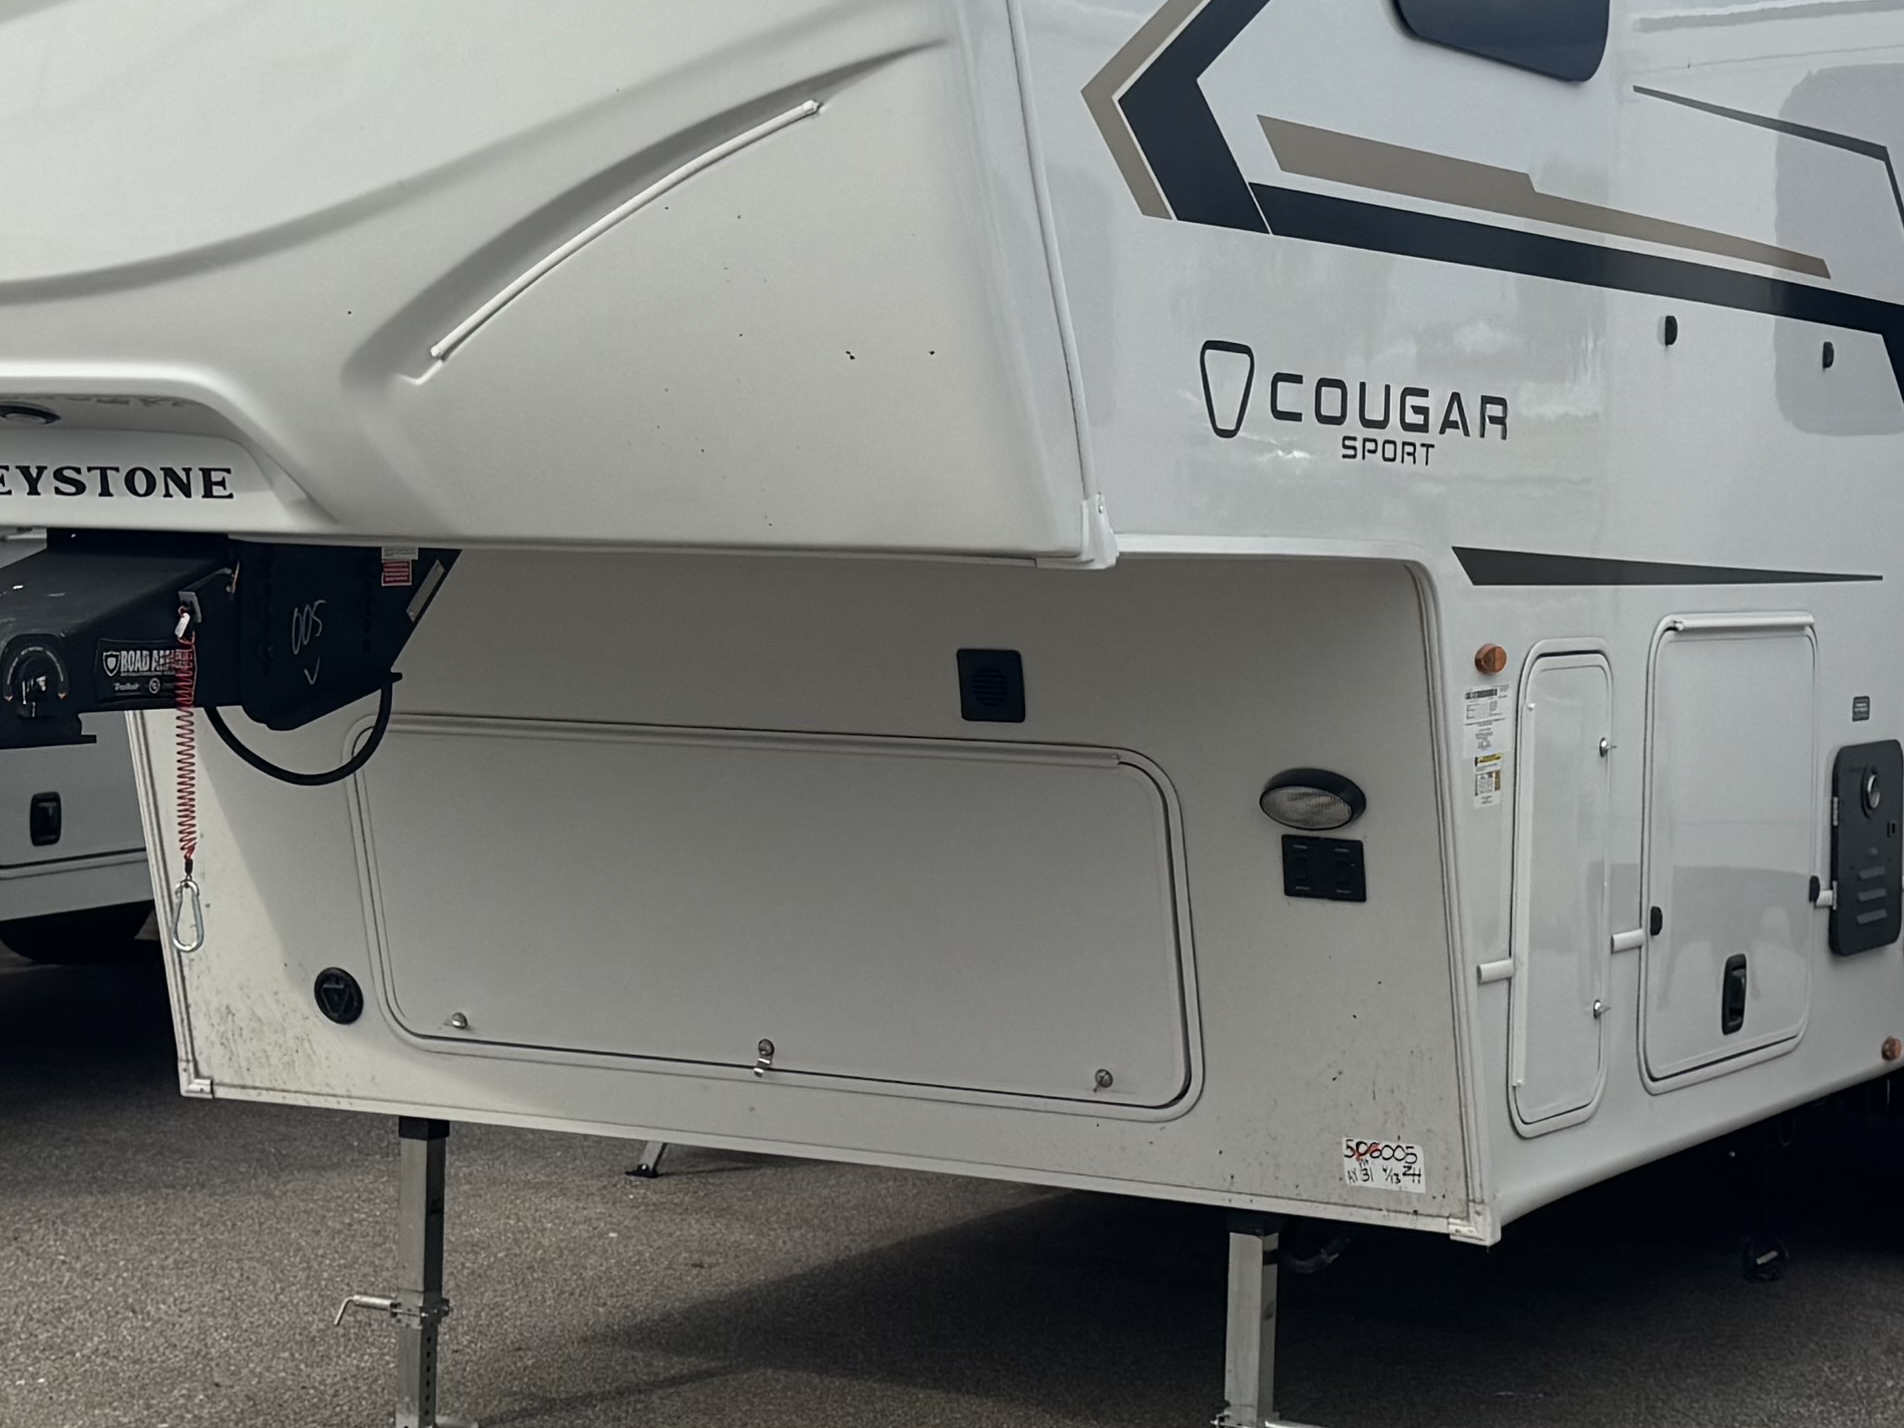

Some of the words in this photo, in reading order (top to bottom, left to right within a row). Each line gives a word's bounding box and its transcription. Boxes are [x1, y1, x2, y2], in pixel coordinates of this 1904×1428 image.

[1270, 371, 1508, 441] COUGAR
[1341, 435, 1436, 466] SPORT
[120, 650, 150, 672] ROAD
